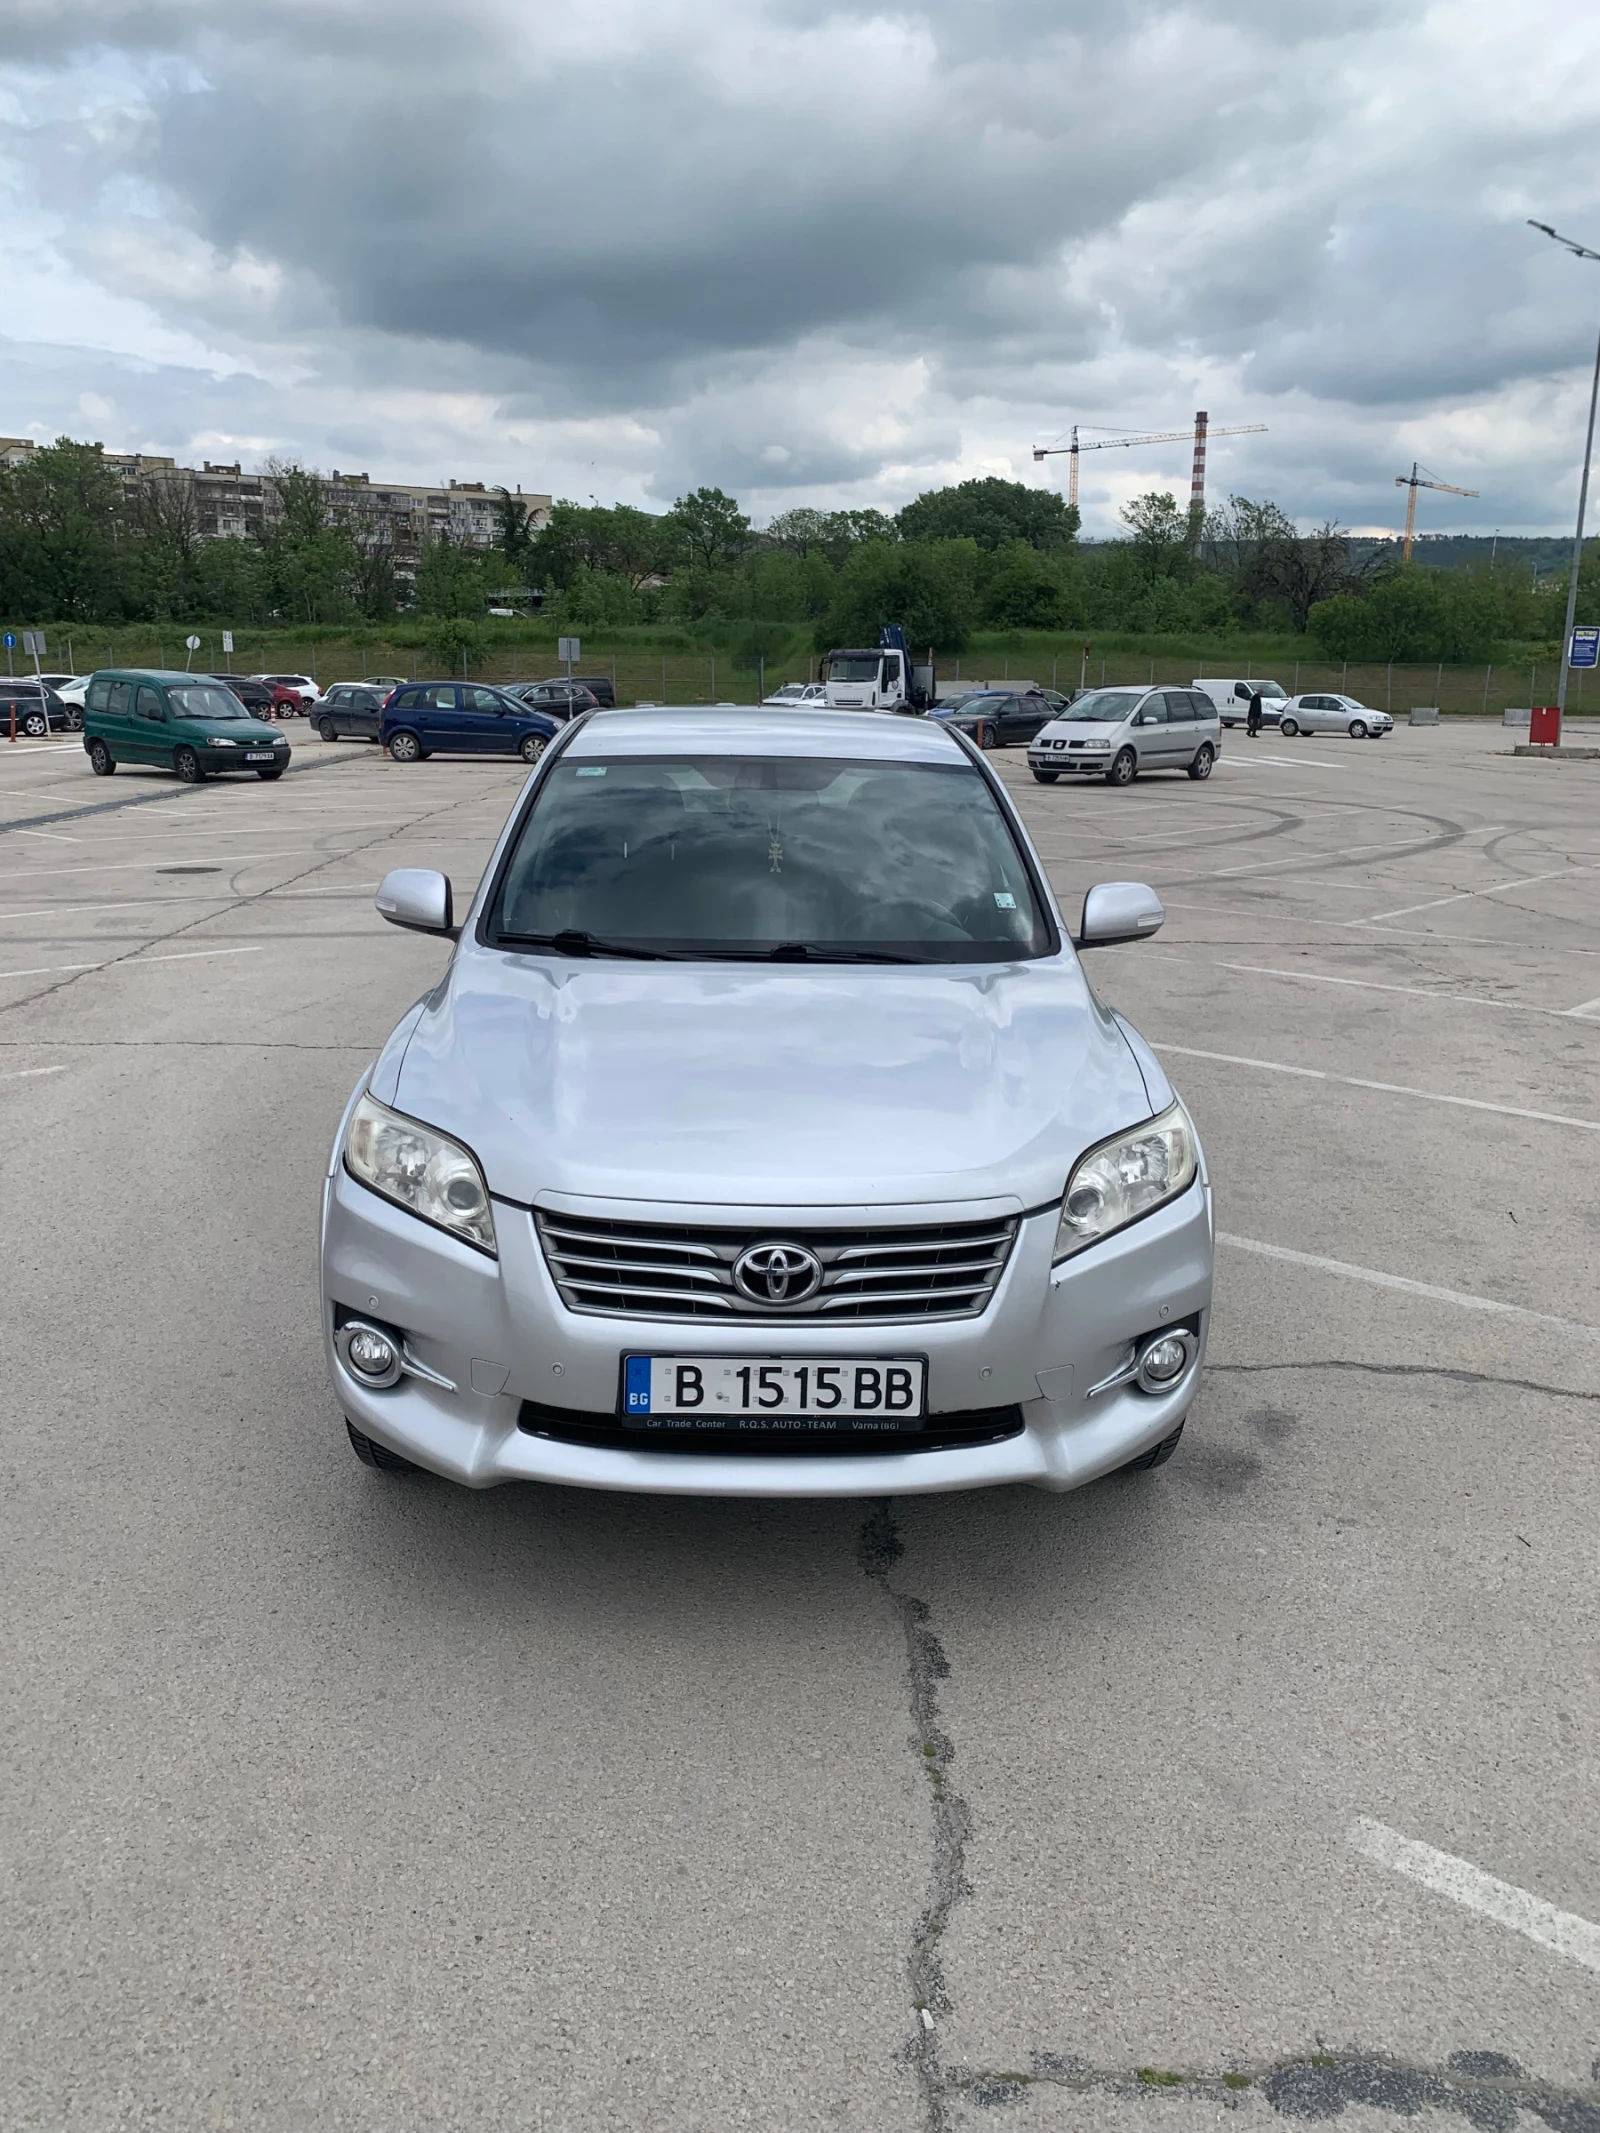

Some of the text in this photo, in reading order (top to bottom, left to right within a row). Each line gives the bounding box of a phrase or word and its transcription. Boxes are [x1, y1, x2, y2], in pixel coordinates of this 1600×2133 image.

[675, 1365, 913, 1411] B 1515 BB
[629, 1392, 649, 1405] BG
[646, 1419, 662, 1428] Car
[666, 1419, 692, 1428] Trade
[695, 1420, 727, 1429] Center
[852, 1422, 879, 1430] Varna
[880, 1422, 900, 1431] (BG)
